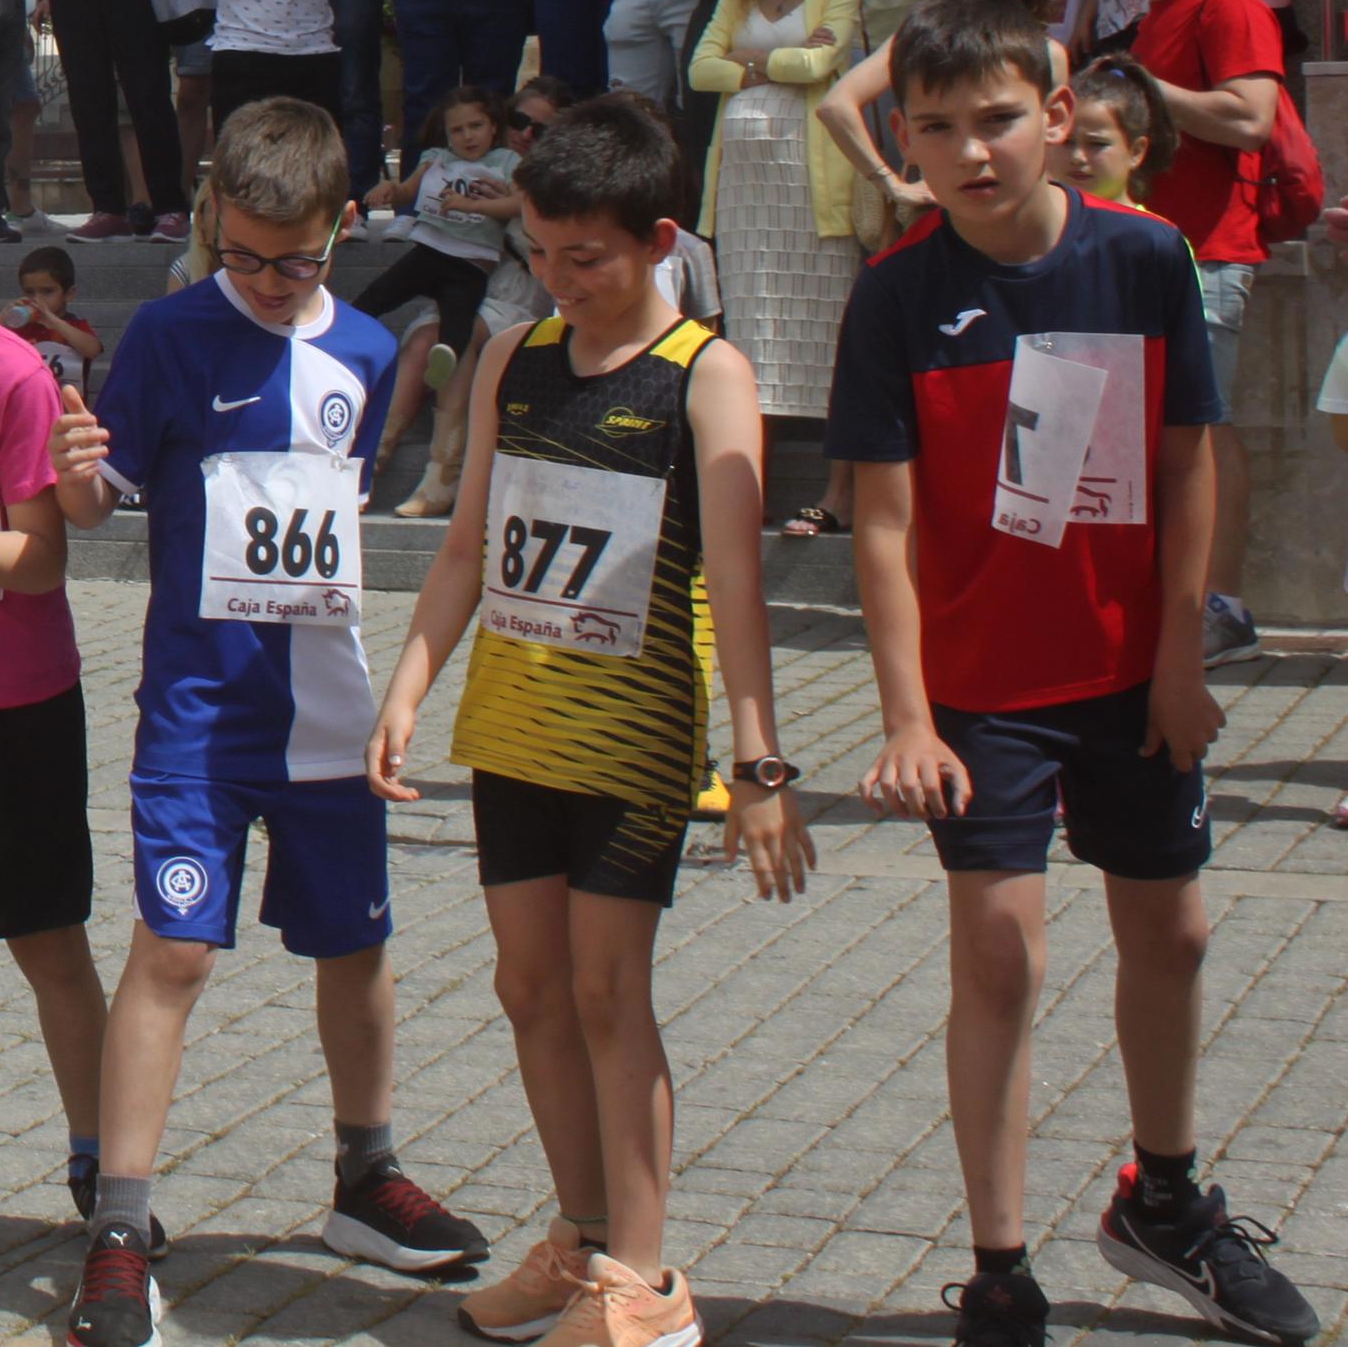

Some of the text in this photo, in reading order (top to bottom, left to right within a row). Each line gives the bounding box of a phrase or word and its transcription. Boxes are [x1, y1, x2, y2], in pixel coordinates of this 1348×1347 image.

[245, 506, 339, 579] 866
[501, 515, 613, 600] 877
[227, 598, 317, 618] Caja España
[510, 615, 562, 638] España
